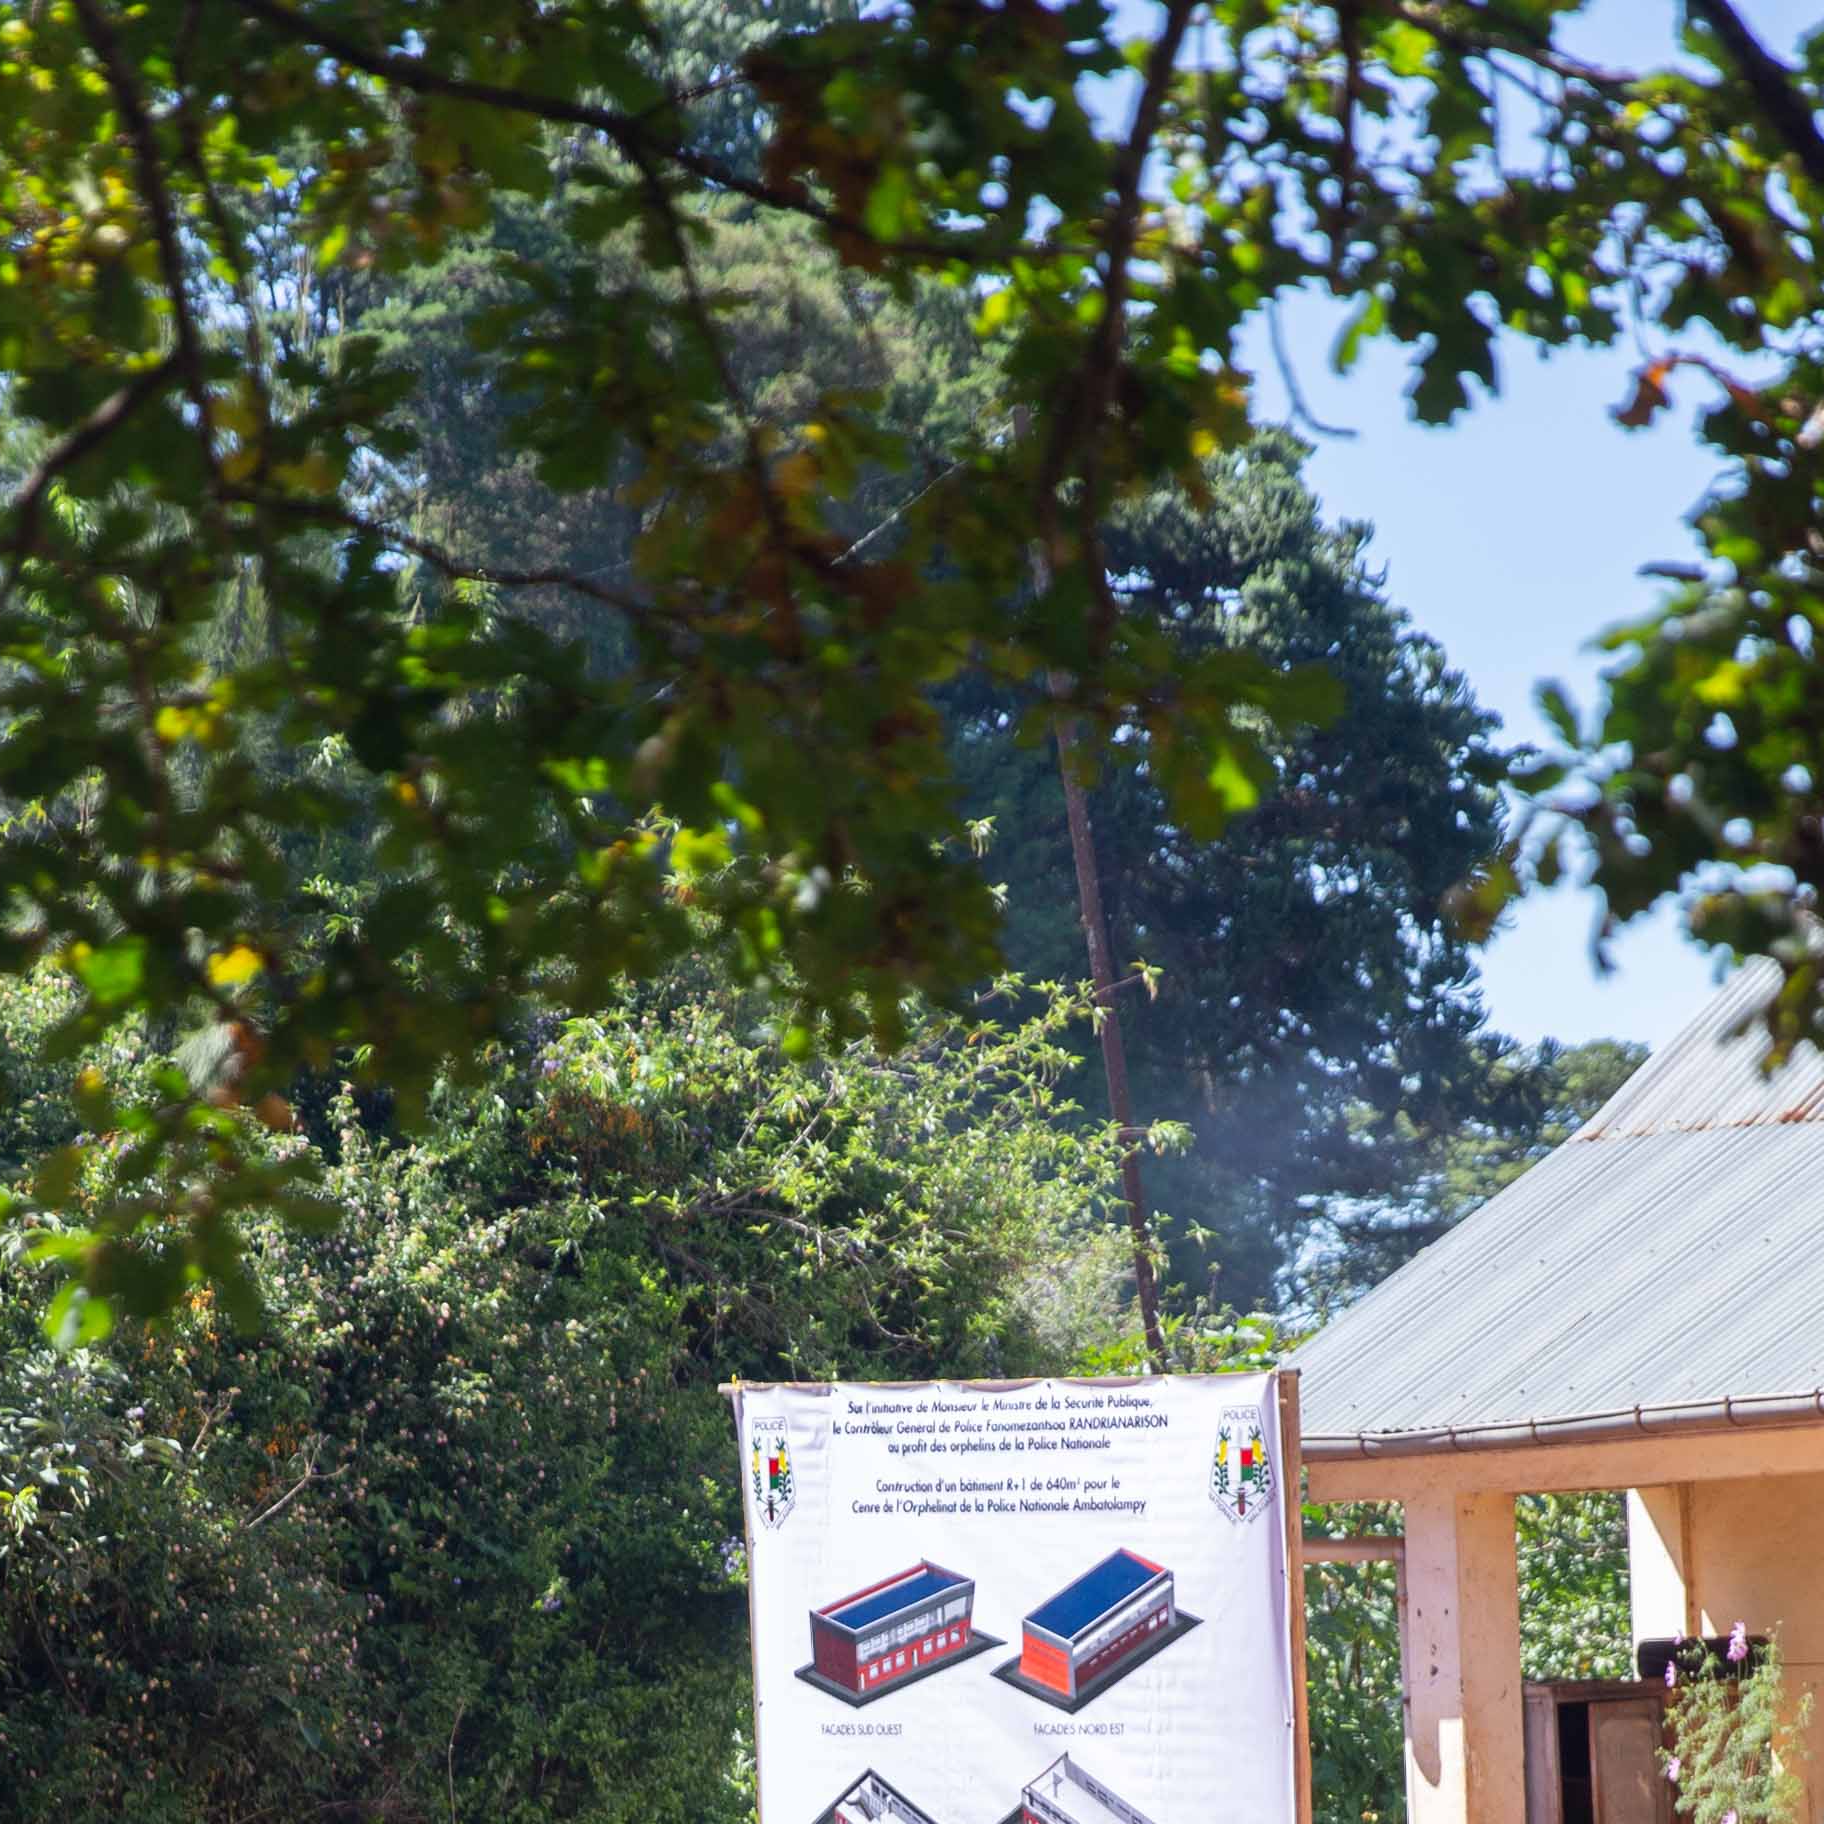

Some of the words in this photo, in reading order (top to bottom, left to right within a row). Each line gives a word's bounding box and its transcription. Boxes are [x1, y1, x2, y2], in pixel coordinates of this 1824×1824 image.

[847, 1401, 863, 1415] Sur
[916, 1400, 929, 1414] de
[931, 1401, 977, 1413] Monsieur
[980, 1397, 991, 1412] le
[1035, 1397, 1048, 1410] de
[1051, 1396, 1061, 1409] la
[1107, 1394, 1153, 1411] Publique,
[832, 1421, 842, 1435] le
[844, 1420, 894, 1435] Contrôleur
[938, 1419, 951, 1433] de
[954, 1418, 983, 1433] Police
[1069, 1413, 1169, 1431] RANDRIANARISON
[887, 1441, 899, 1453] au
[901, 1438, 927, 1456] profit
[929, 1438, 948, 1453] des
[950, 1436, 996, 1455] orphelins
[998, 1436, 1012, 1451] de
[1015, 1435, 1025, 1450] la
[1028, 1434, 1058, 1450] Police
[1061, 1434, 1112, 1450] Nationale
[935, 1477, 957, 1492] d'un
[959, 1476, 1004, 1492] bâtiment
[1030, 1476, 1043, 1490] de
[1083, 1478, 1108, 1494] pour
[1111, 1474, 1121, 1490] le
[883, 1498, 894, 1513] de
[959, 1497, 972, 1513] de
[974, 1497, 985, 1513] la
[987, 1498, 1017, 1513] Police
[1019, 1496, 1071, 1512] Nationale
[1073, 1495, 1147, 1514] Ambatolampy
[1078, 1722, 1108, 1736] NORD
